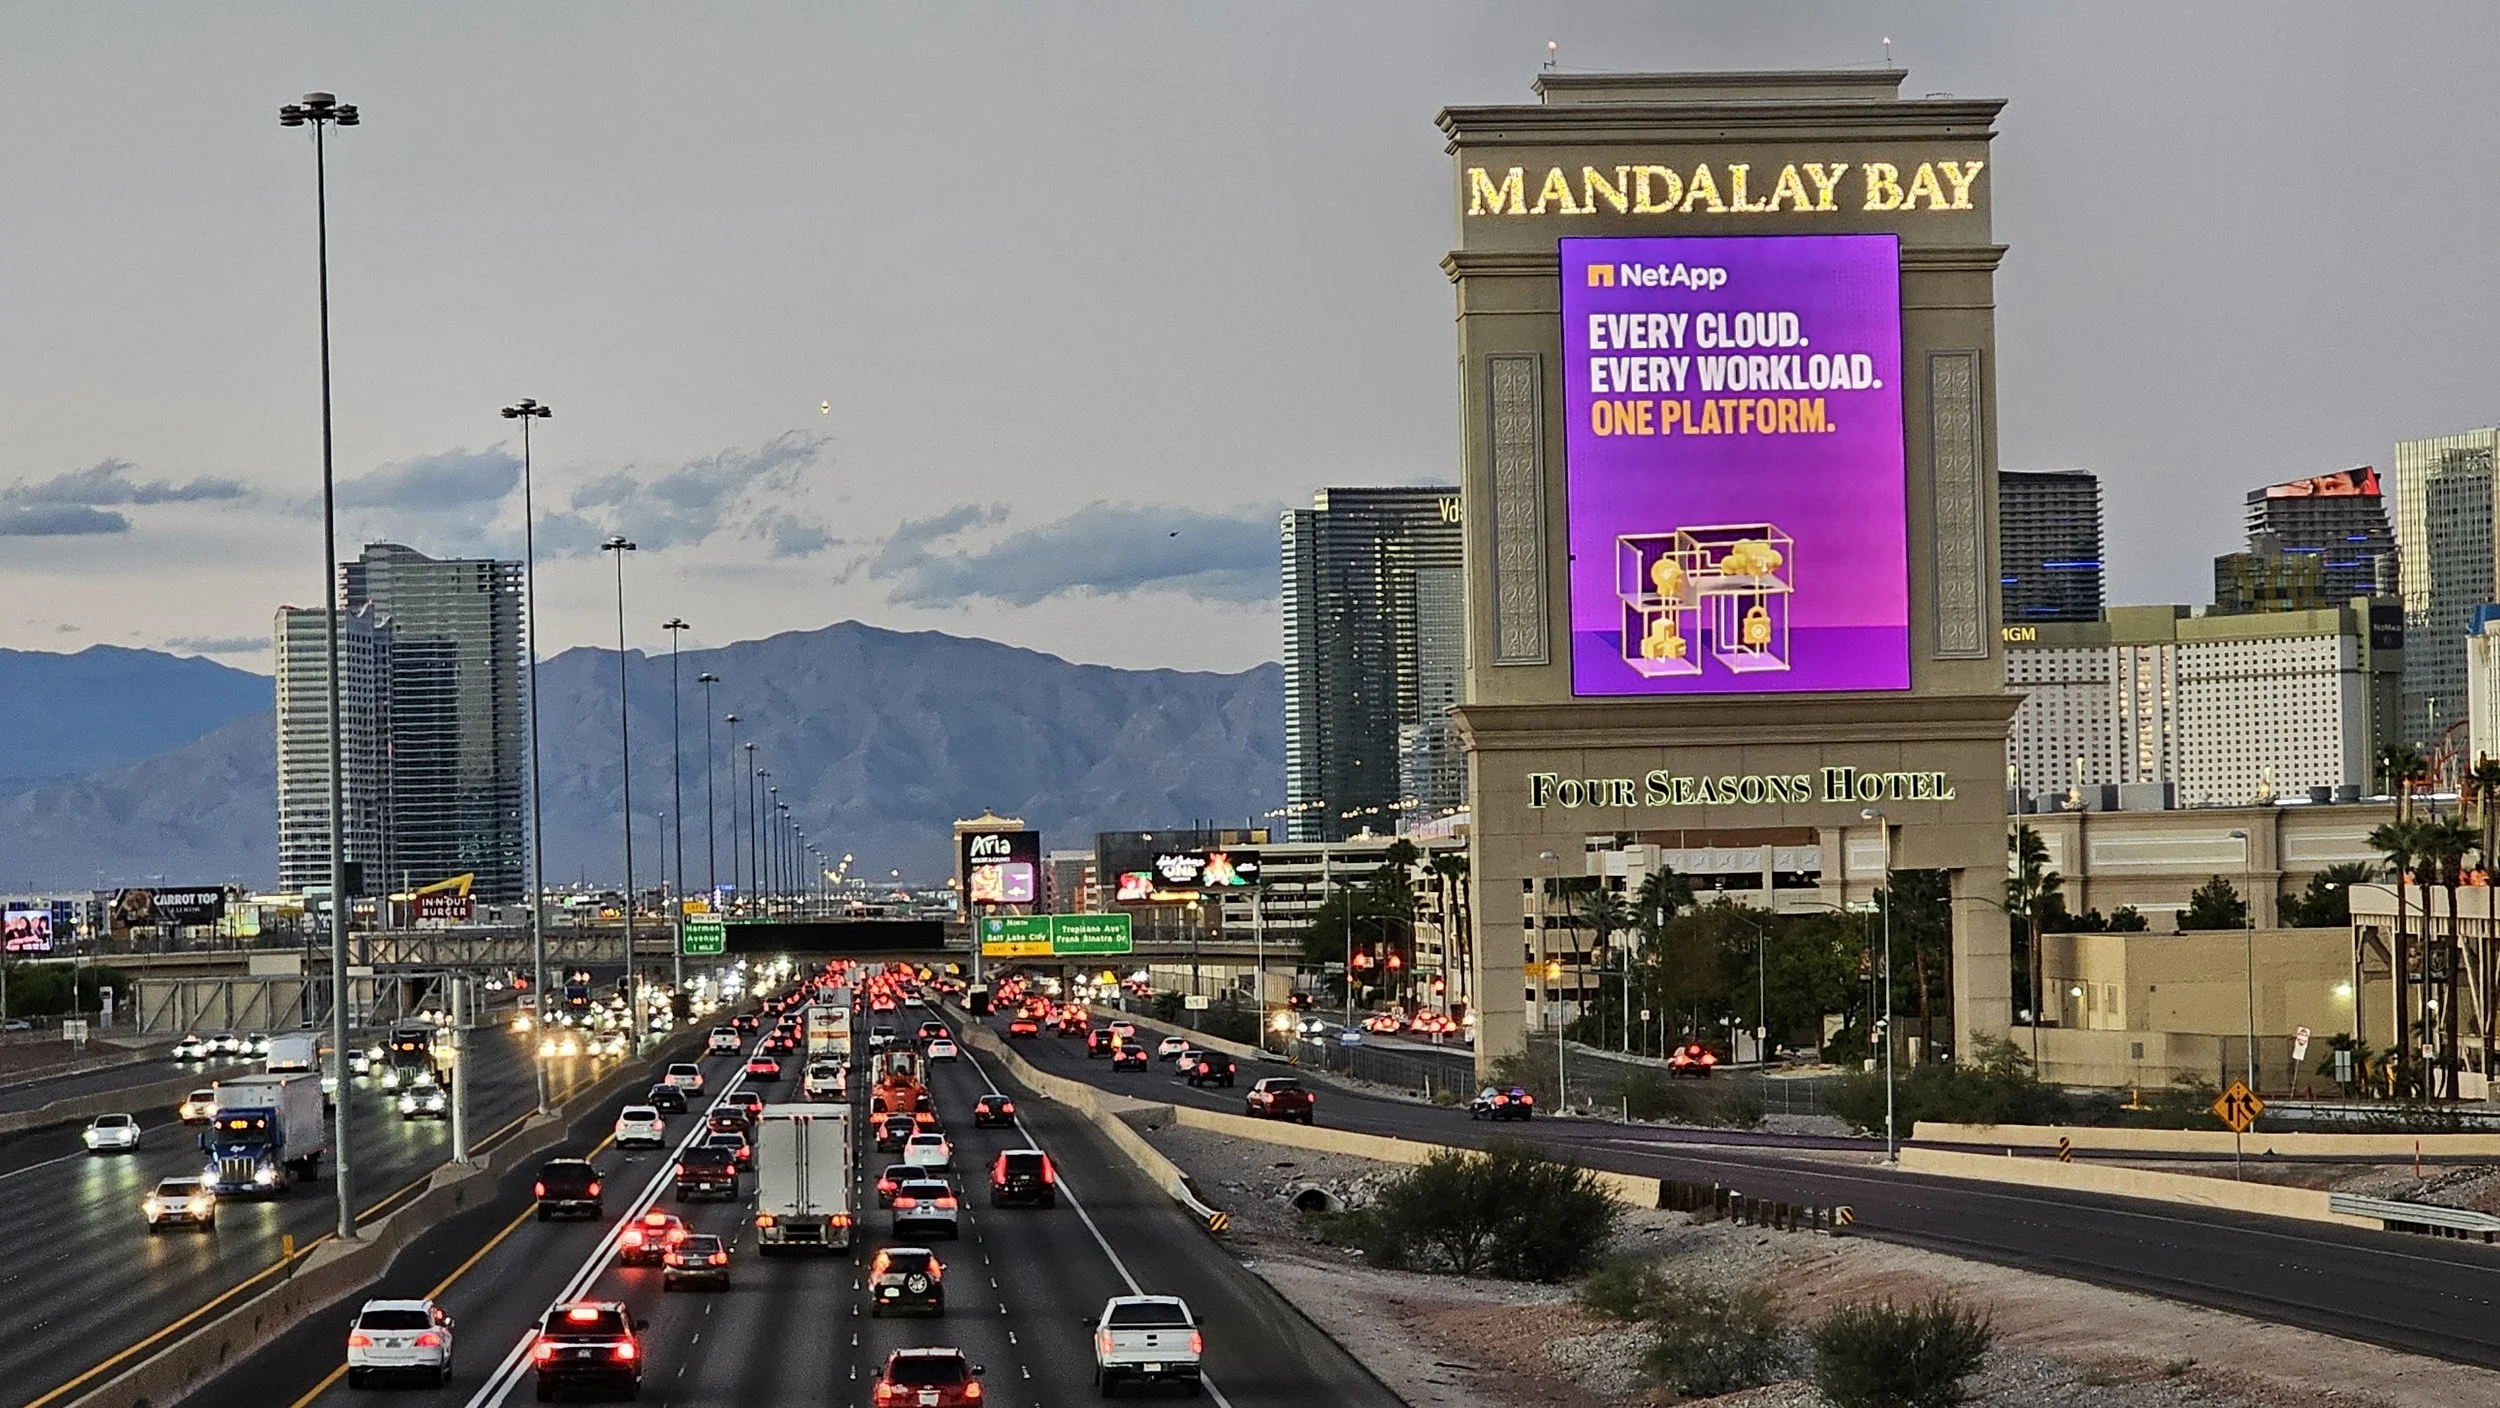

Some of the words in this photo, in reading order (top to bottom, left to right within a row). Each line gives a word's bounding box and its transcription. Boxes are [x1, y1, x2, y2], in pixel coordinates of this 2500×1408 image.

[1467, 163, 1849, 215] MANDALAY
[1862, 160, 1985, 212] BAY
[1620, 263, 1728, 290] NetApp
[1588, 314, 1689, 350] EVERY
[1696, 312, 1810, 348] CLOUD.
[1590, 356, 1690, 393] EVERY
[1697, 353, 1883, 391] WORKLOAD.
[1591, 401, 1654, 436] ONE
[1661, 397, 1837, 435] PLATFORM.
[1438, 497, 1463, 522] Vd
[1527, 771, 1637, 809] FOUR
[1645, 769, 1813, 806] SEASONS
[1820, 766, 1957, 802] HOTEL
[970, 834, 1011, 857] Aria
[153, 894, 196, 906] CARROT
[197, 892, 218, 904] TOP
[421, 896, 467, 906] IN-N-OUT
[421, 907, 467, 917] BURGER
[686, 924, 720, 932] Harmon
[987, 933, 1004, 942] Salt
[1005, 933, 1026, 942] Lake
[1028, 932, 1047, 942] City
[1062, 925, 1101, 934] Tropicana
[1104, 924, 1120, 933] Ave
[687, 934, 720, 942] Avenue
[1056, 934, 1080, 943] Frank
[1082, 933, 1113, 943] Sinatra
[1115, 933, 1127, 942] Dr
